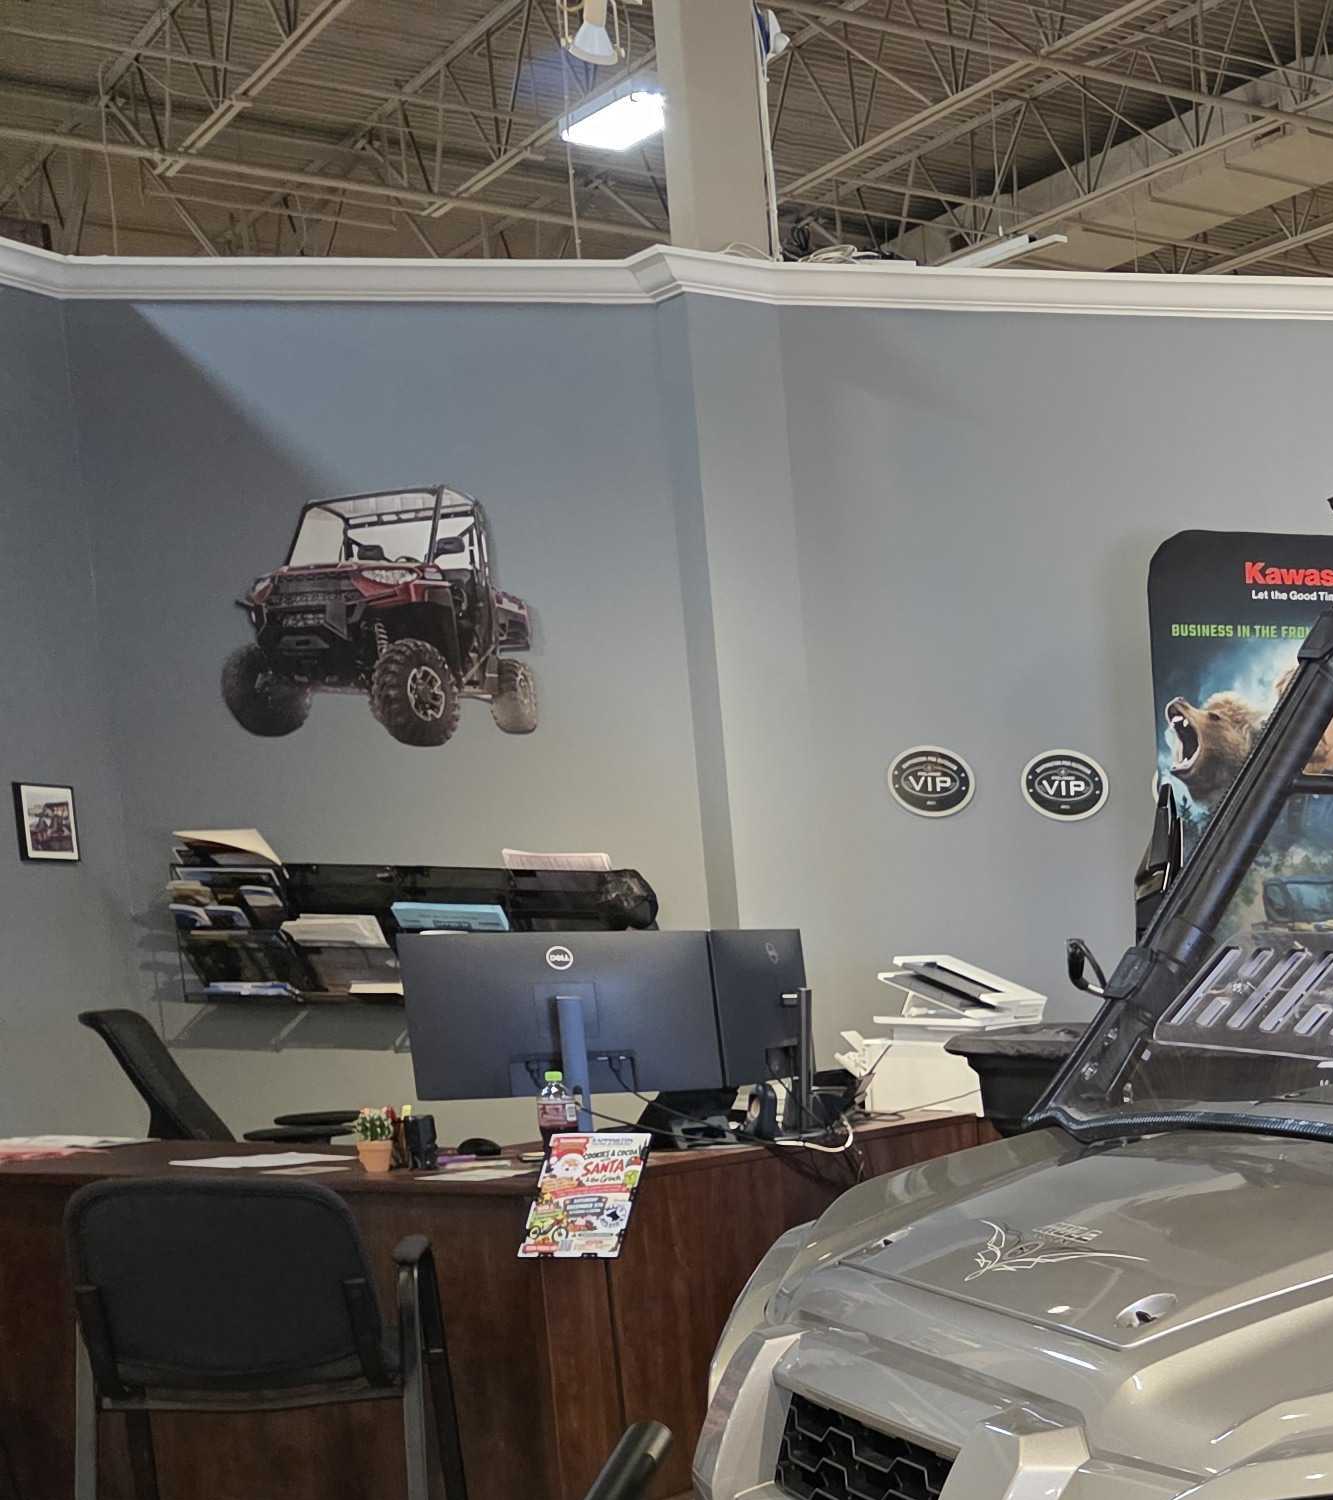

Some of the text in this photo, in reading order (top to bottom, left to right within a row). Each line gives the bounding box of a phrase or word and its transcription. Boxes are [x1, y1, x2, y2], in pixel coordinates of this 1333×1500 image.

[1252, 590, 1268, 600] Let
[1271, 590, 1287, 600] the
[1289, 591, 1317, 601] Good
[1172, 624, 1233, 637] BUSINESS
[1238, 625, 1250, 638] IN
[1255, 625, 1277, 638] THE
[907, 775, 952, 792] VIP
[1042, 779, 1086, 796] VIP
[581, 1159, 624, 1177] SANTA
